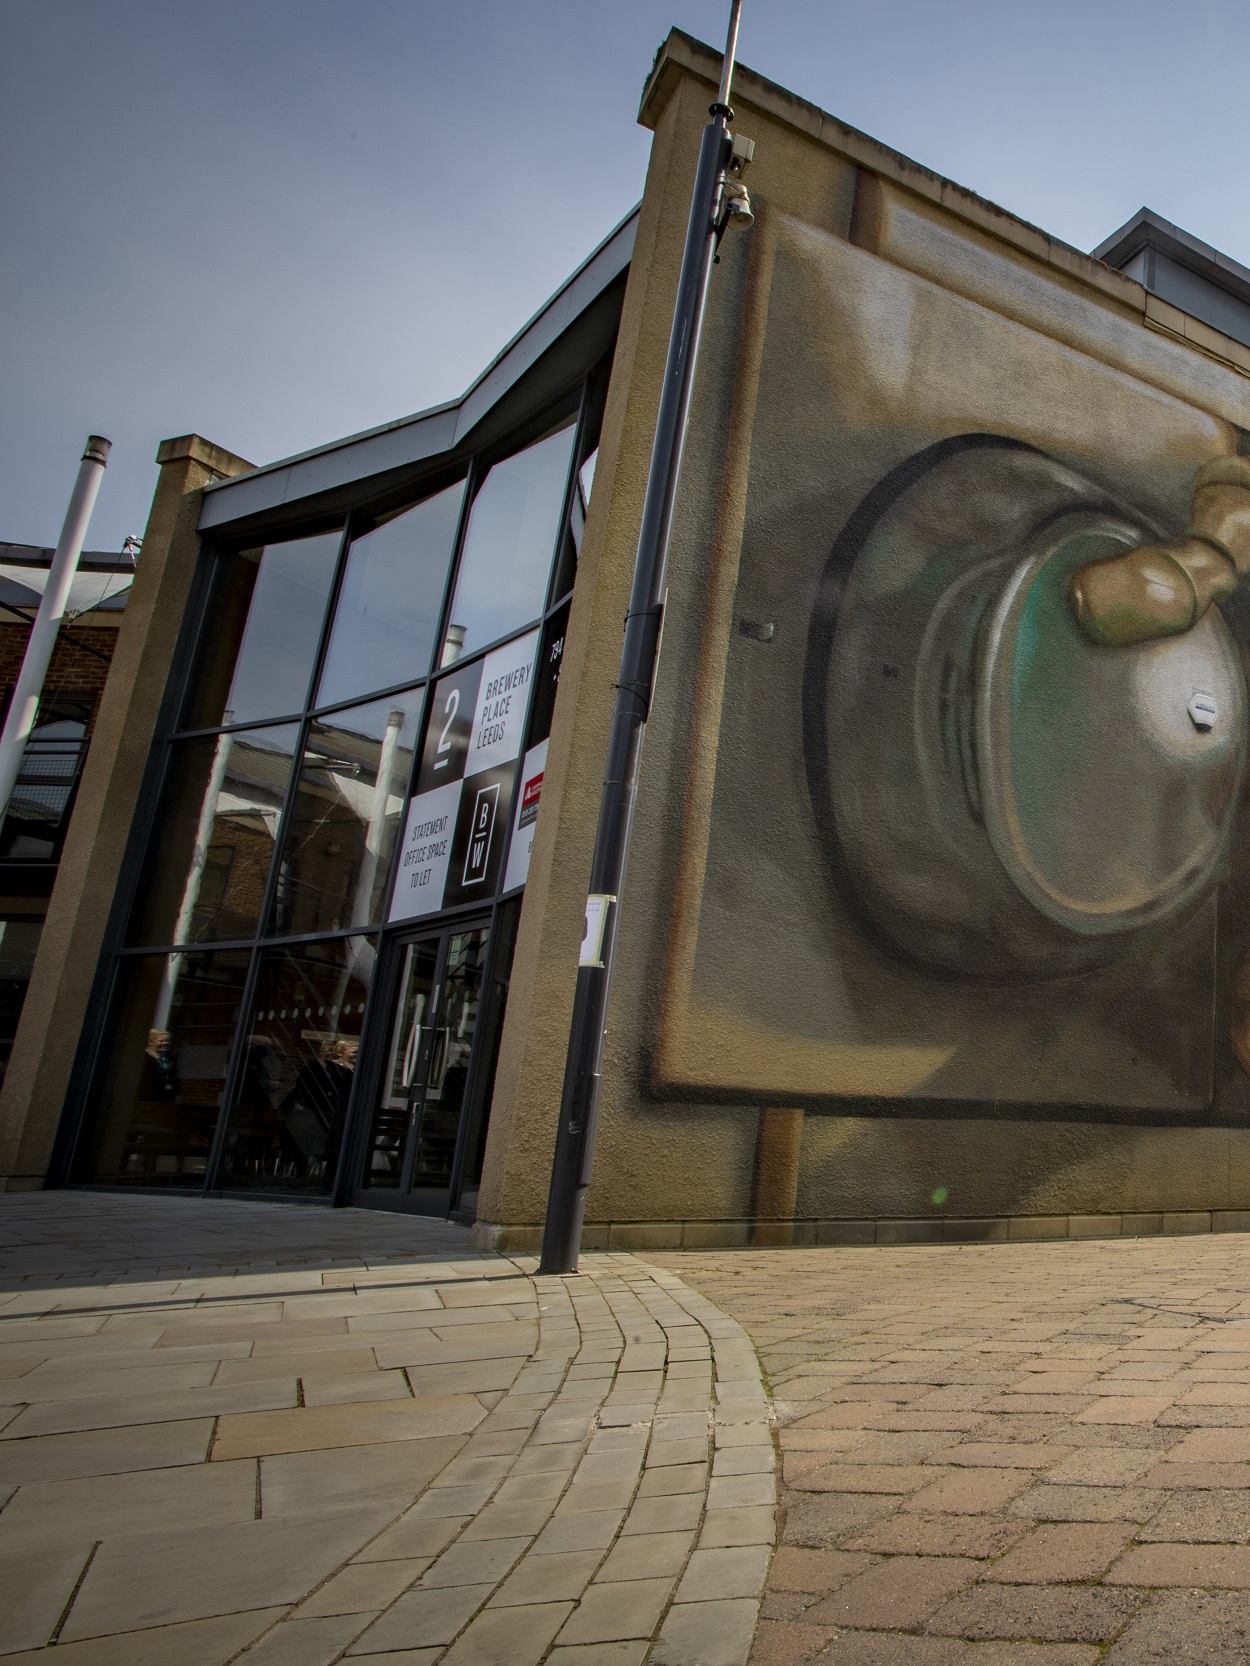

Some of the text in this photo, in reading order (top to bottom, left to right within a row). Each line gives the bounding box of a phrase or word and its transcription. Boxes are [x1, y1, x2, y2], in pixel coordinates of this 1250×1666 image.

[485, 662, 533, 701] BREWERY
[437, 688, 460, 754] 2
[480, 695, 512, 726] PLACE
[476, 720, 506, 750] LEEDS
[412, 815, 449, 842] STATEMENT
[479, 802, 489, 829] B
[403, 839, 448, 867] OFFICE SPACE
[471, 840, 485, 869] W
[410, 868, 432, 889] TO LET
